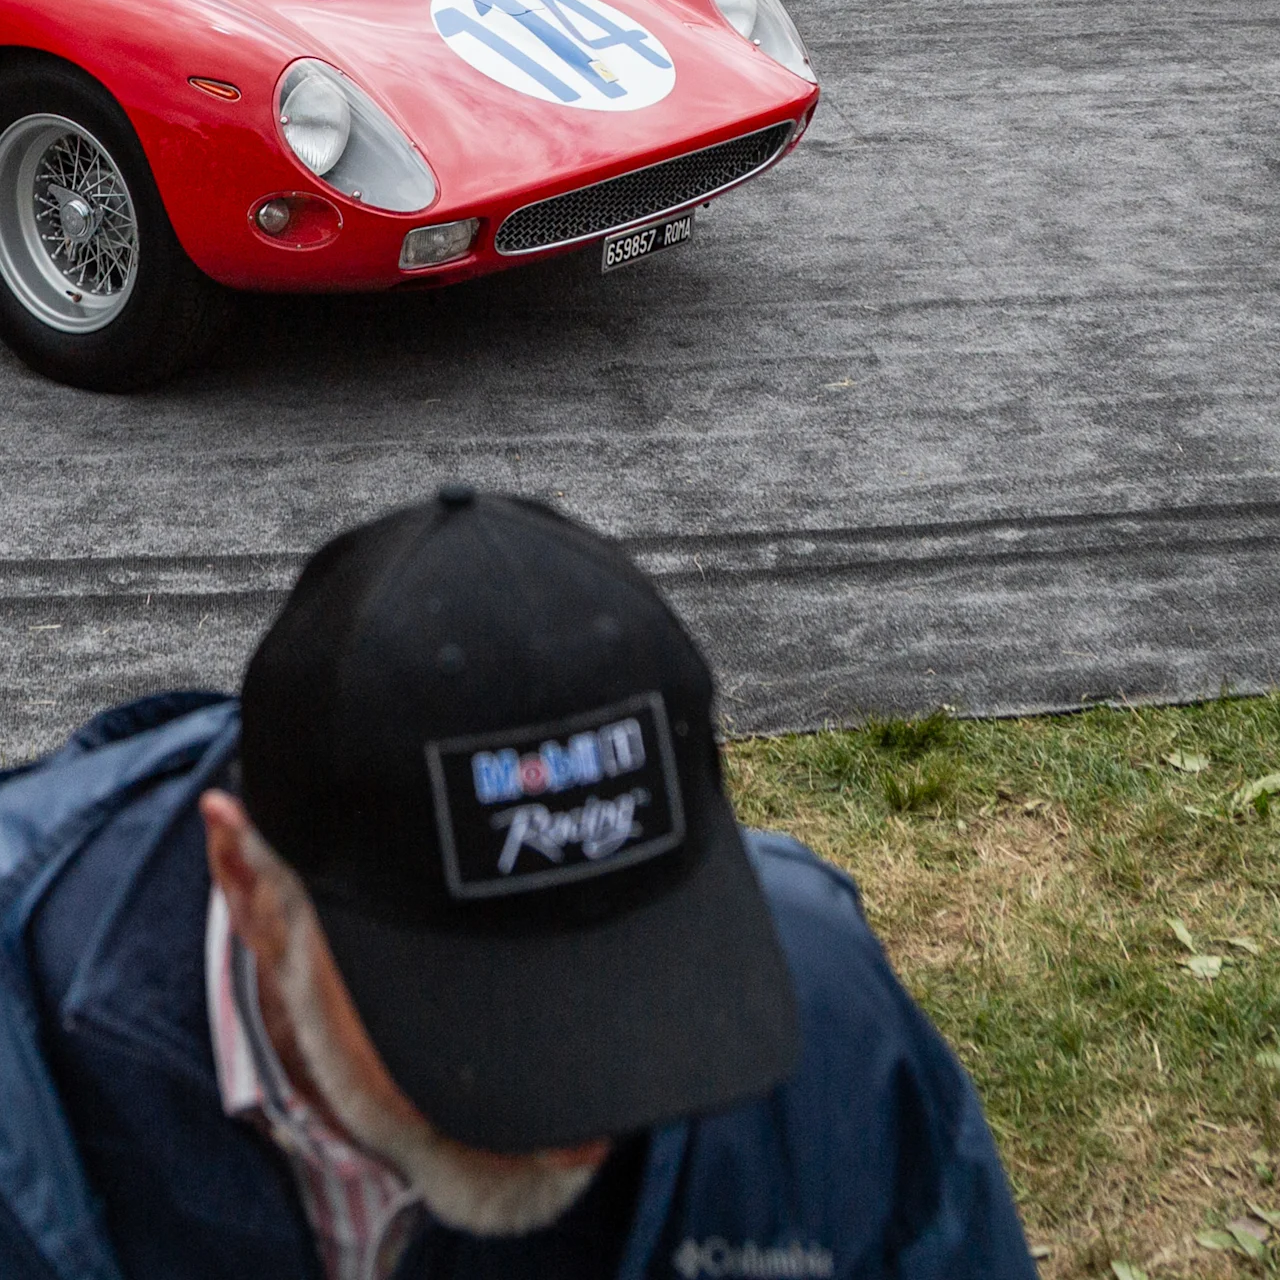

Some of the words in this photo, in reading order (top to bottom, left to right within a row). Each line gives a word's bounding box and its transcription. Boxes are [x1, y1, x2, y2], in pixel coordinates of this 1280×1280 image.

[606, 229, 657, 266] 659857
[663, 217, 691, 247] ROMA
[472, 729, 604, 805] Mobil
